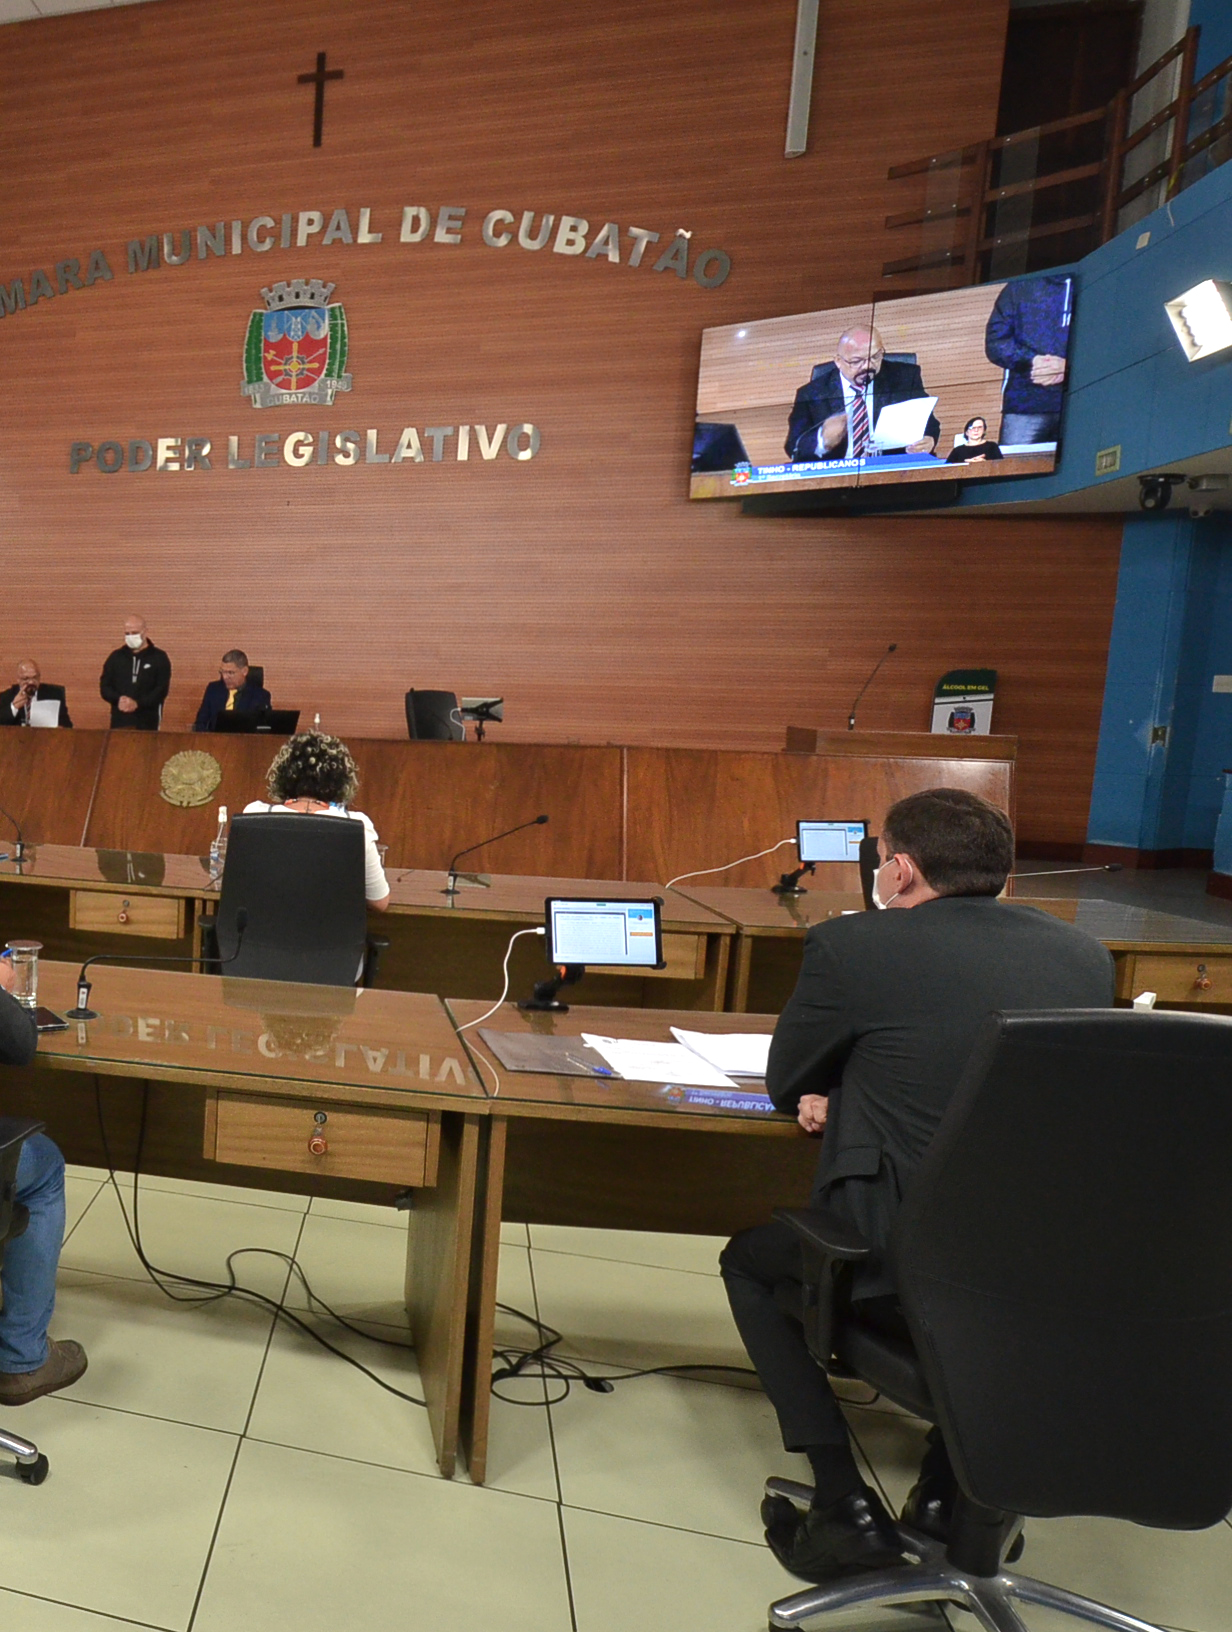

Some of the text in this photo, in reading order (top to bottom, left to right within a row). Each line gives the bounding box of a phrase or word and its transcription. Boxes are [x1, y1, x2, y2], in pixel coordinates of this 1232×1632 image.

[126, 207, 382, 274] MUNICIPAL
[400, 206, 466, 244] DE
[482, 209, 731, 289] CUBATÃO
[266, 393, 320, 405] CUBATÃO
[69, 423, 541, 474] PODER LEGISLATIVO
[757, 465, 786, 475] TINHO
[791, 458, 866, 472] REPUBLICANOS
